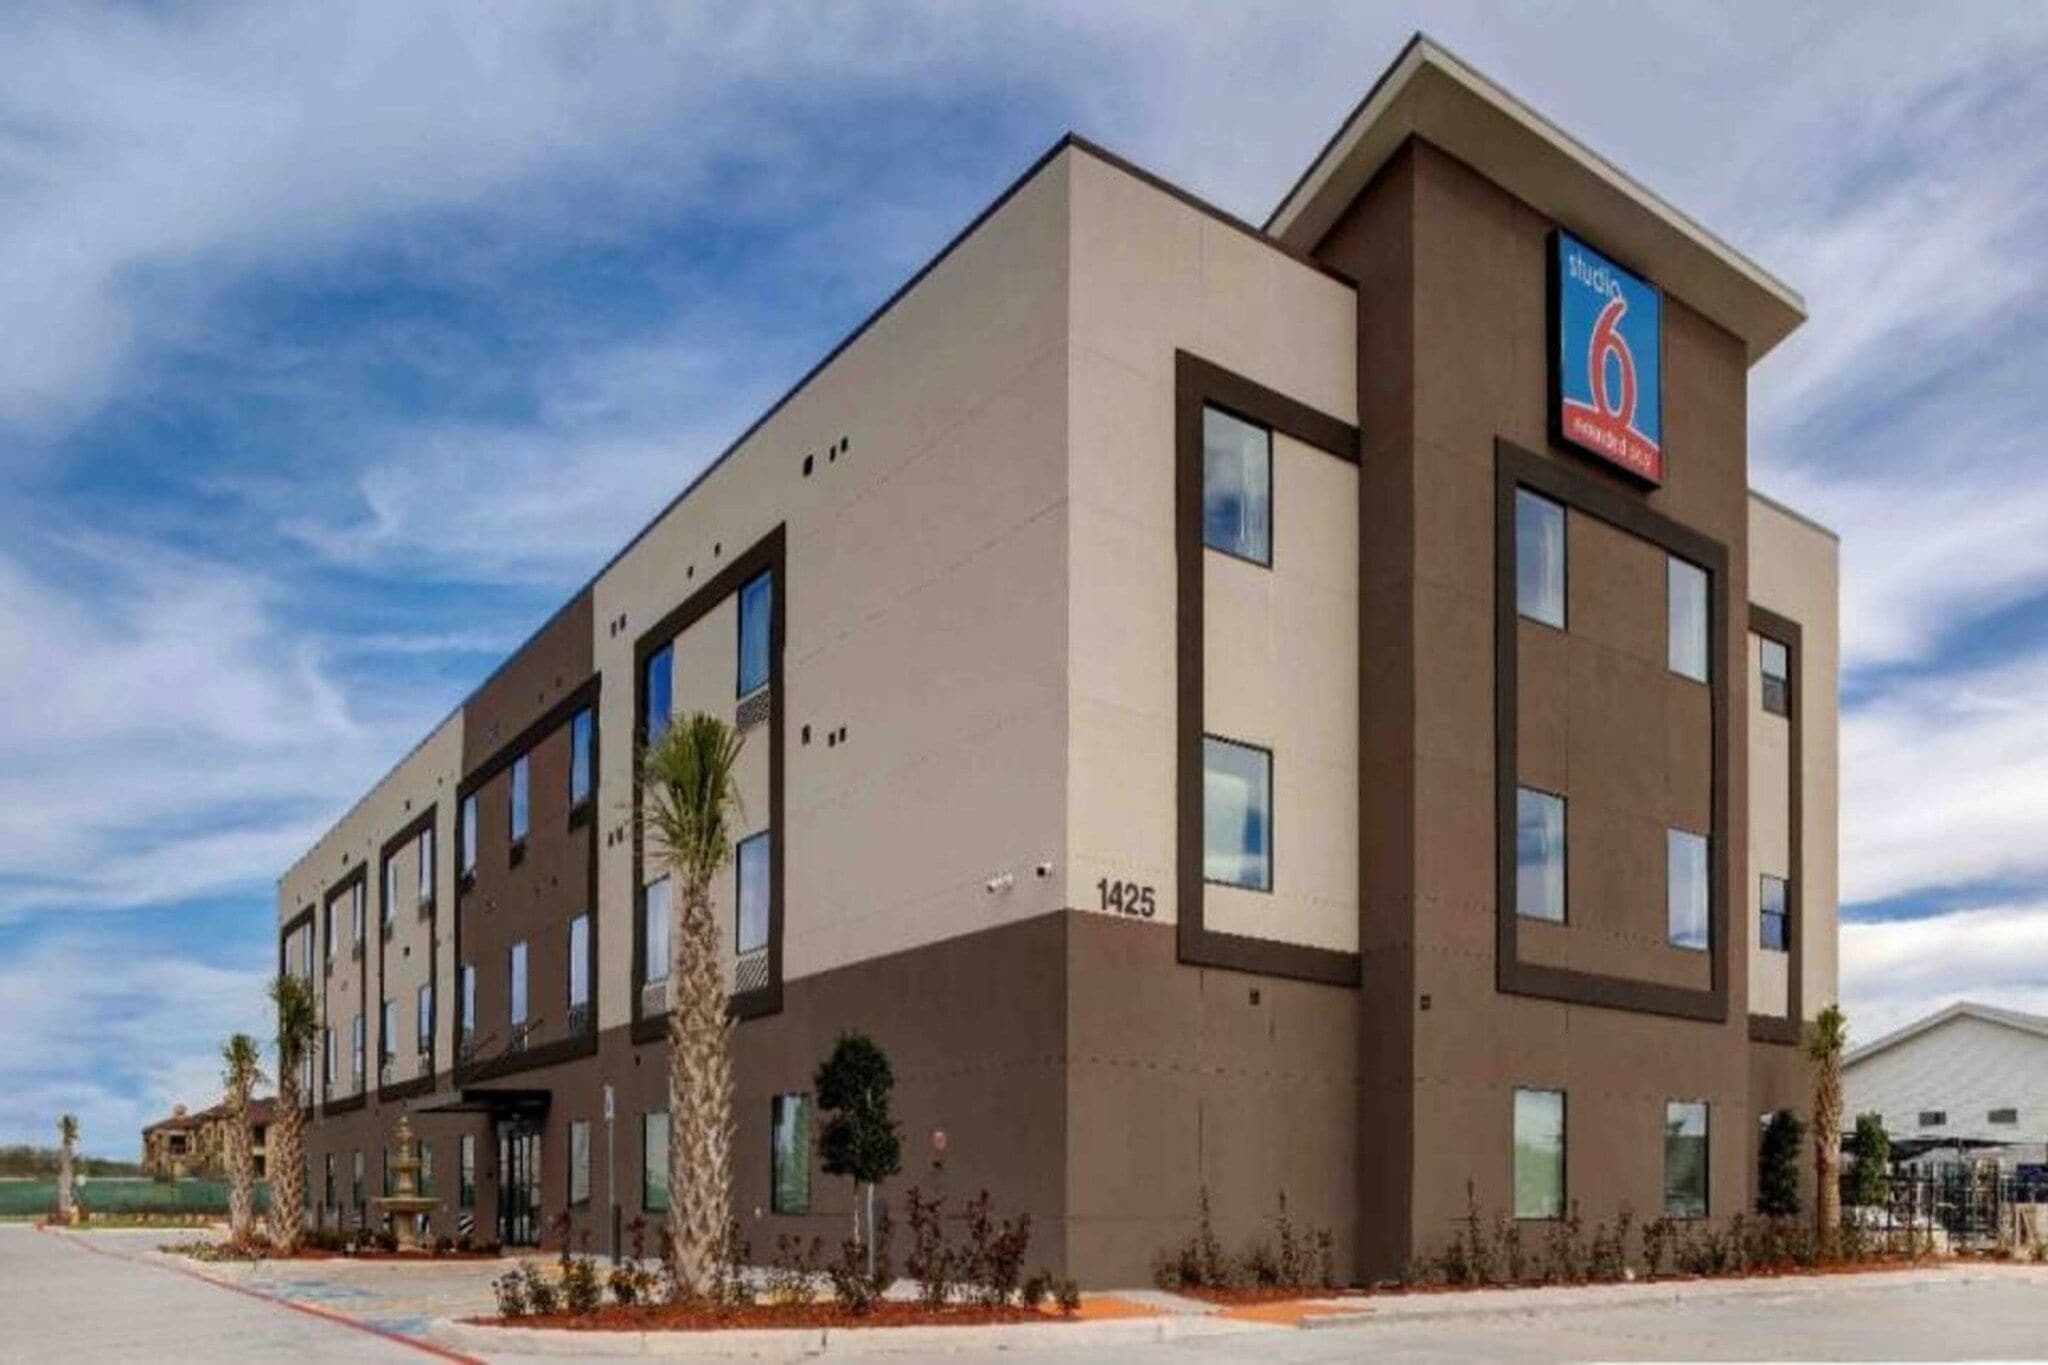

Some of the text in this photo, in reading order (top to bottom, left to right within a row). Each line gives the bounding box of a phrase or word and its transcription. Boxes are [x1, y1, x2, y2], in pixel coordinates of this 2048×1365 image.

[1569, 253, 1622, 299] studio
[1588, 298, 1637, 426] 6
[1097, 877, 1156, 917] 1425
